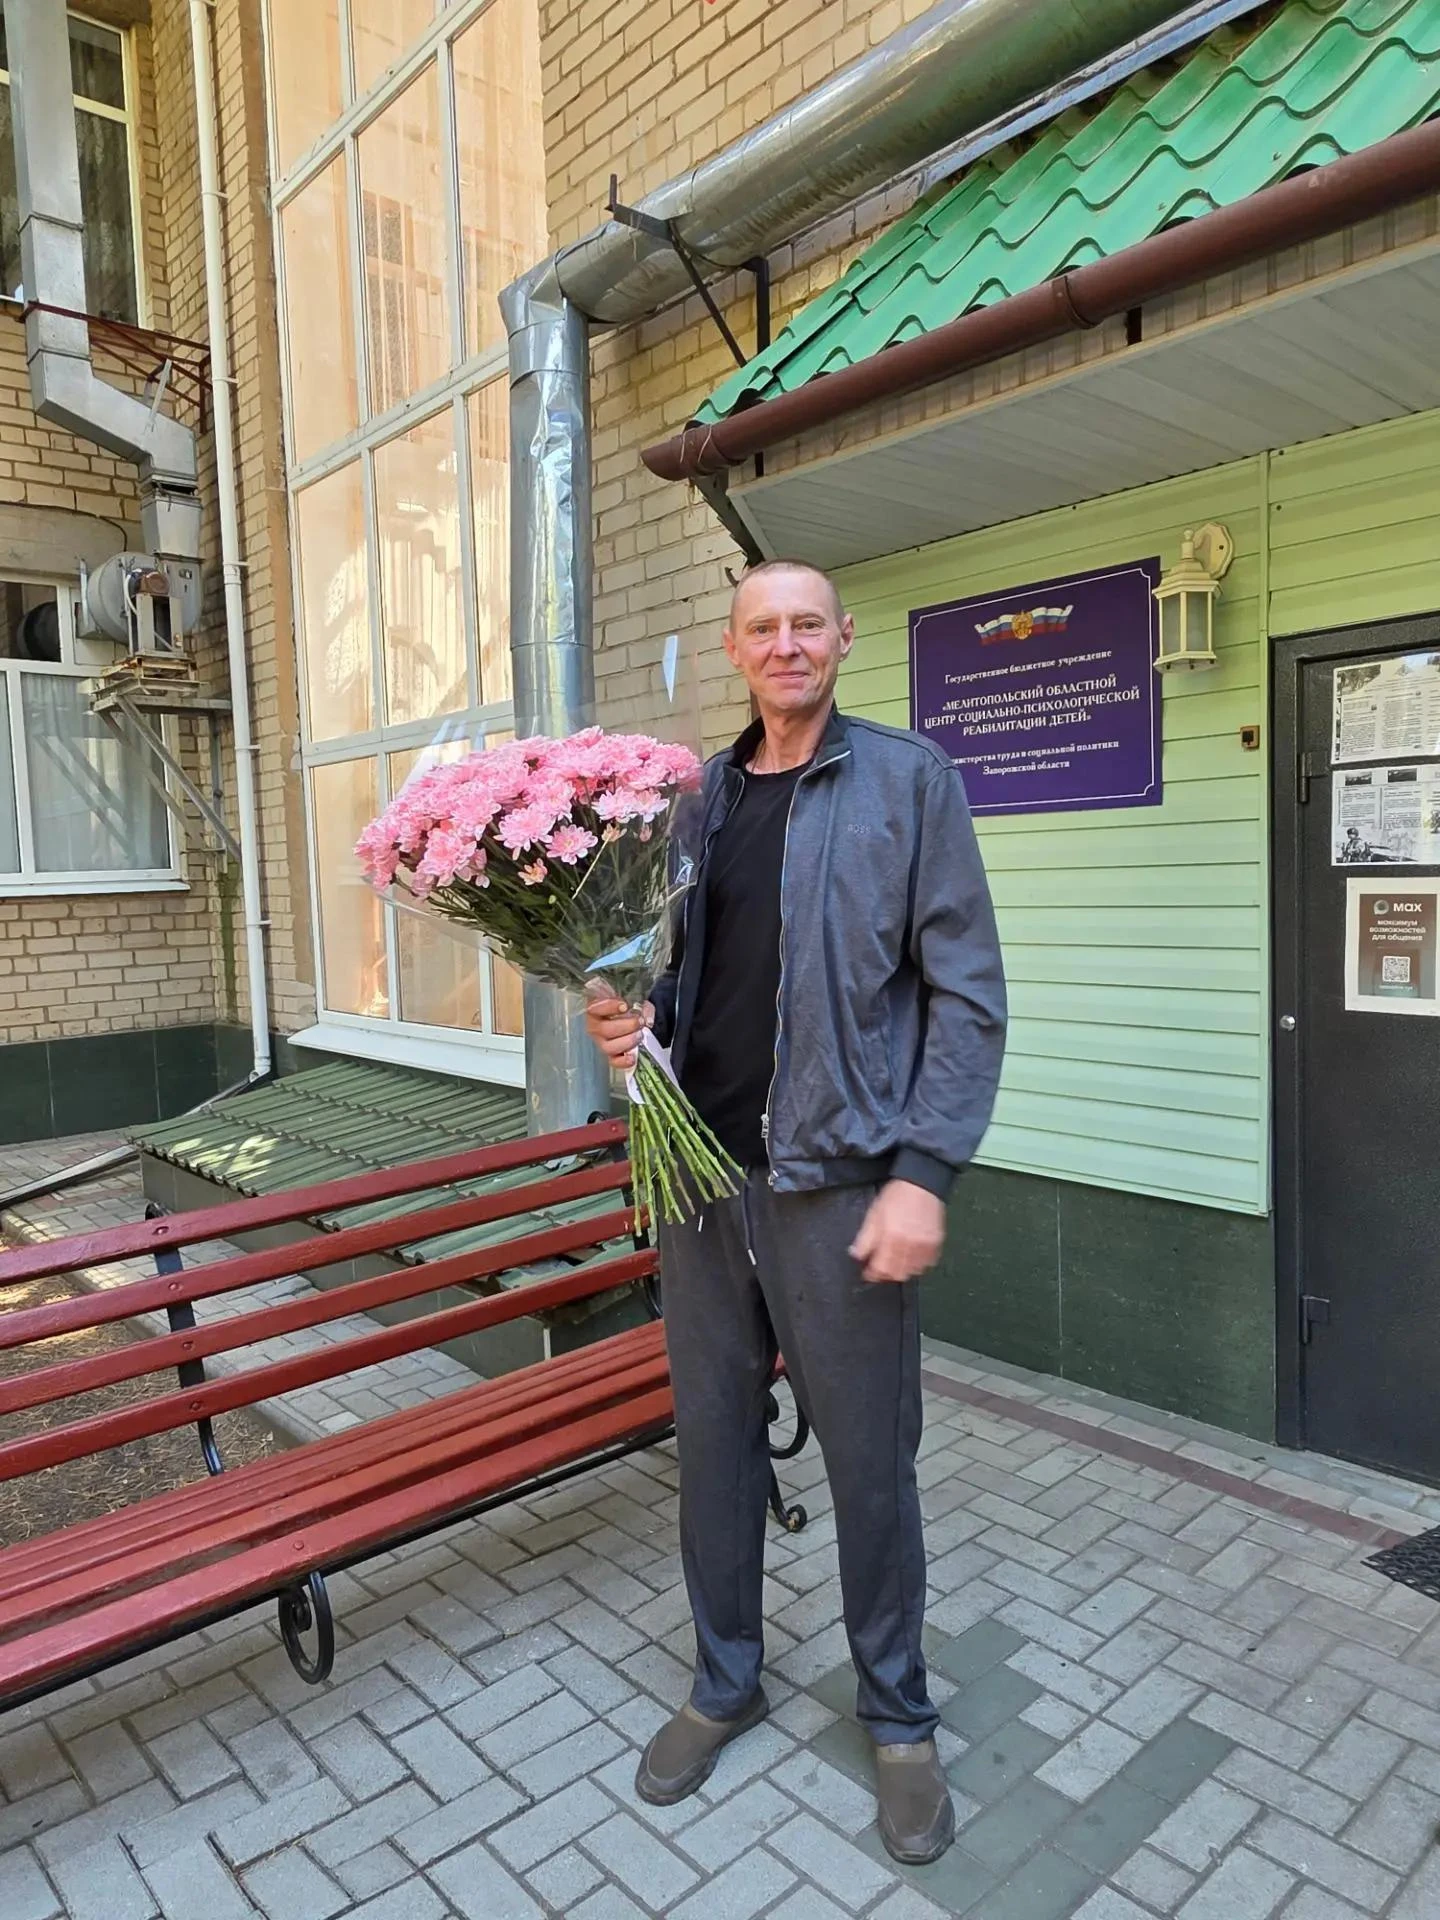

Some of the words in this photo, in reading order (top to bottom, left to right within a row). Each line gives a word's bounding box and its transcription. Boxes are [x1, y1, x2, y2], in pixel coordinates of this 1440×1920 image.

[945, 667, 1009, 684] Государственное
[1009, 660, 1056, 673] бюджетное
[1058, 650, 1112, 667] учреждение
[924, 714, 956, 729] ЦЕНТР
[958, 685, 1140, 723] СОЦИАЛЬНО-ПСИХОЛОГИЧЕСКОЙ
[942, 684, 1044, 711] «МЕЛИТОПОЛЬСКИЙ
[1046, 673, 1117, 697] ОБЛАСТНОЙ
[963, 716, 1046, 736] РЕАБИЛИТАЦИИ
[1048, 708, 1092, 727] ДЕТЕЙ»
[997, 752, 1020, 762] труда
[1027, 743, 1076, 758] социальной
[1076, 741, 1119, 752] политики
[983, 761, 1037, 775] Запорожской
[1037, 761, 1070, 770] области
